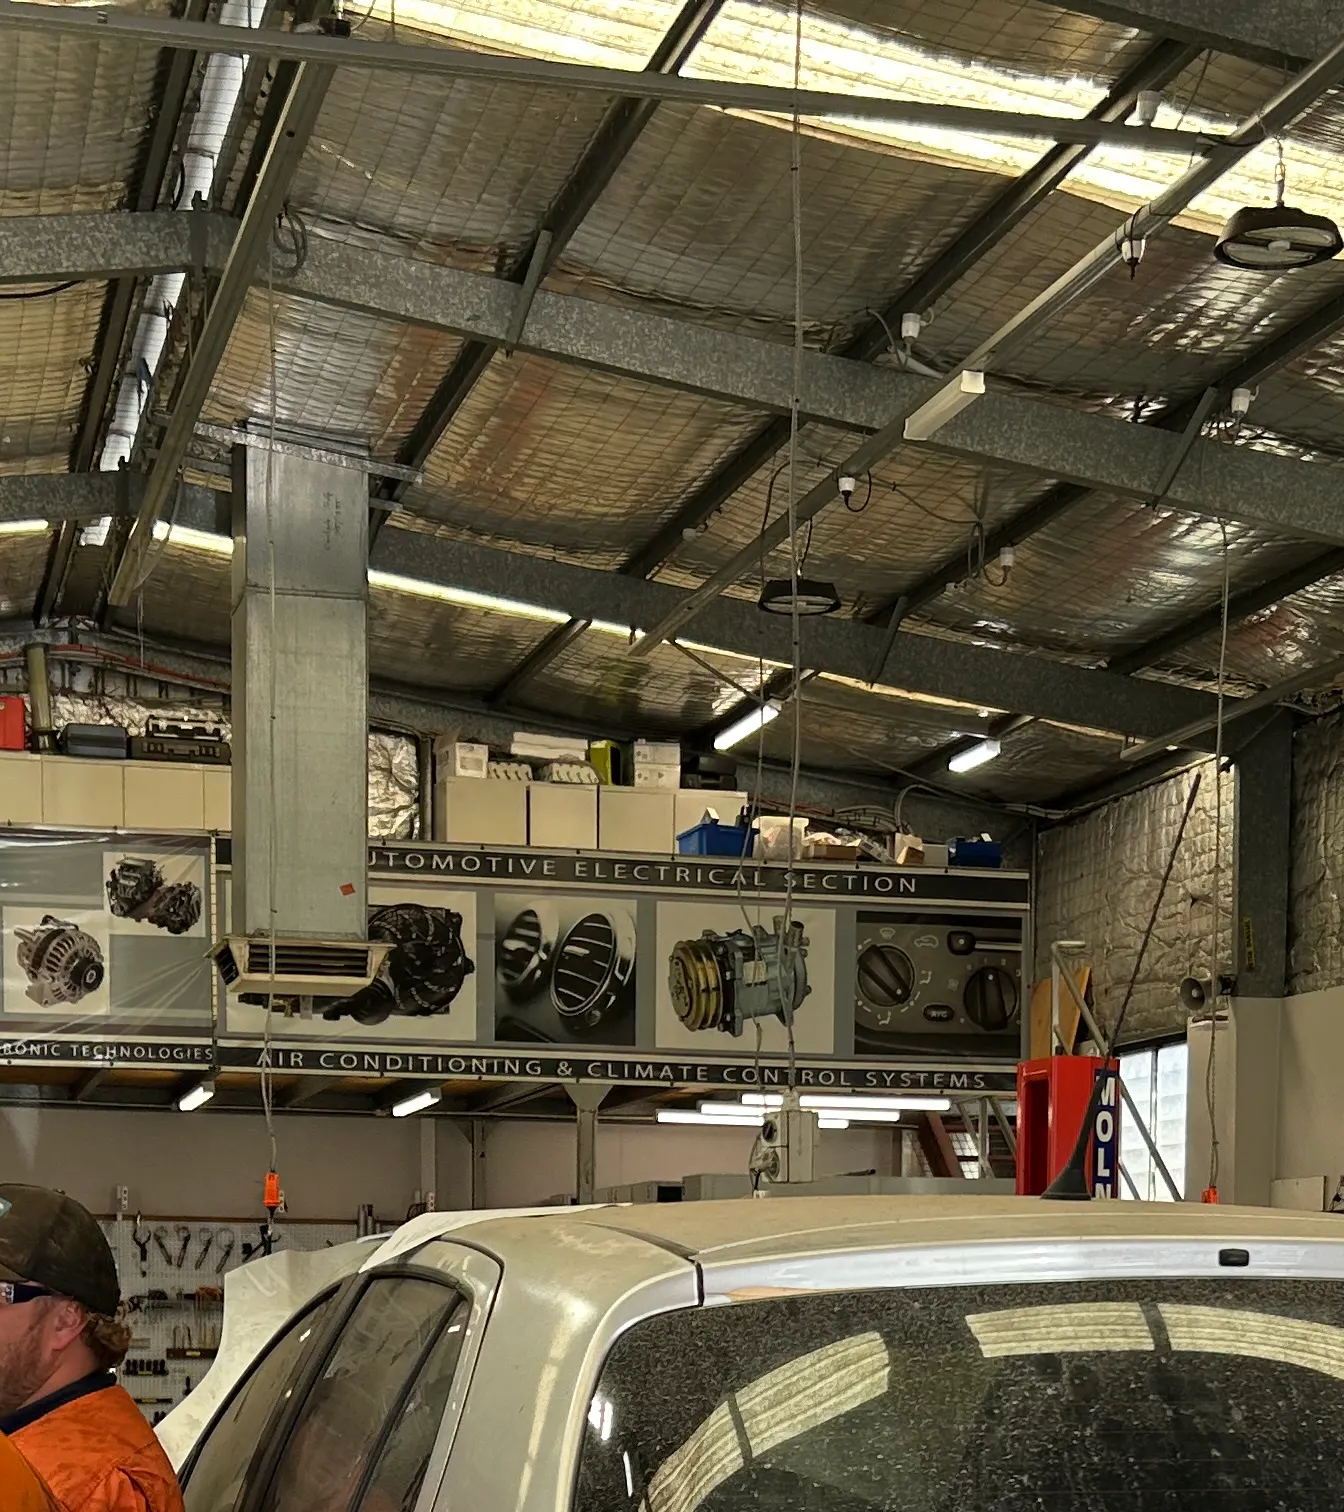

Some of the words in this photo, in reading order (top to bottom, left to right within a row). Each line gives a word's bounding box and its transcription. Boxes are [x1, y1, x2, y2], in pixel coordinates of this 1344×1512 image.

[574, 860, 767, 887] ELECTRICAL
[782, 871, 918, 893] SECTION
[70, 1043, 214, 1060] TECHNOLOGIES
[257, 1051, 304, 1068] AIR
[319, 1052, 542, 1075] CONDITIONING
[556, 1060, 573, 1075] &
[586, 1061, 708, 1082] CLIMATE
[722, 1066, 846, 1086] CONTROL
[865, 1070, 986, 1090] SYSTEMS
